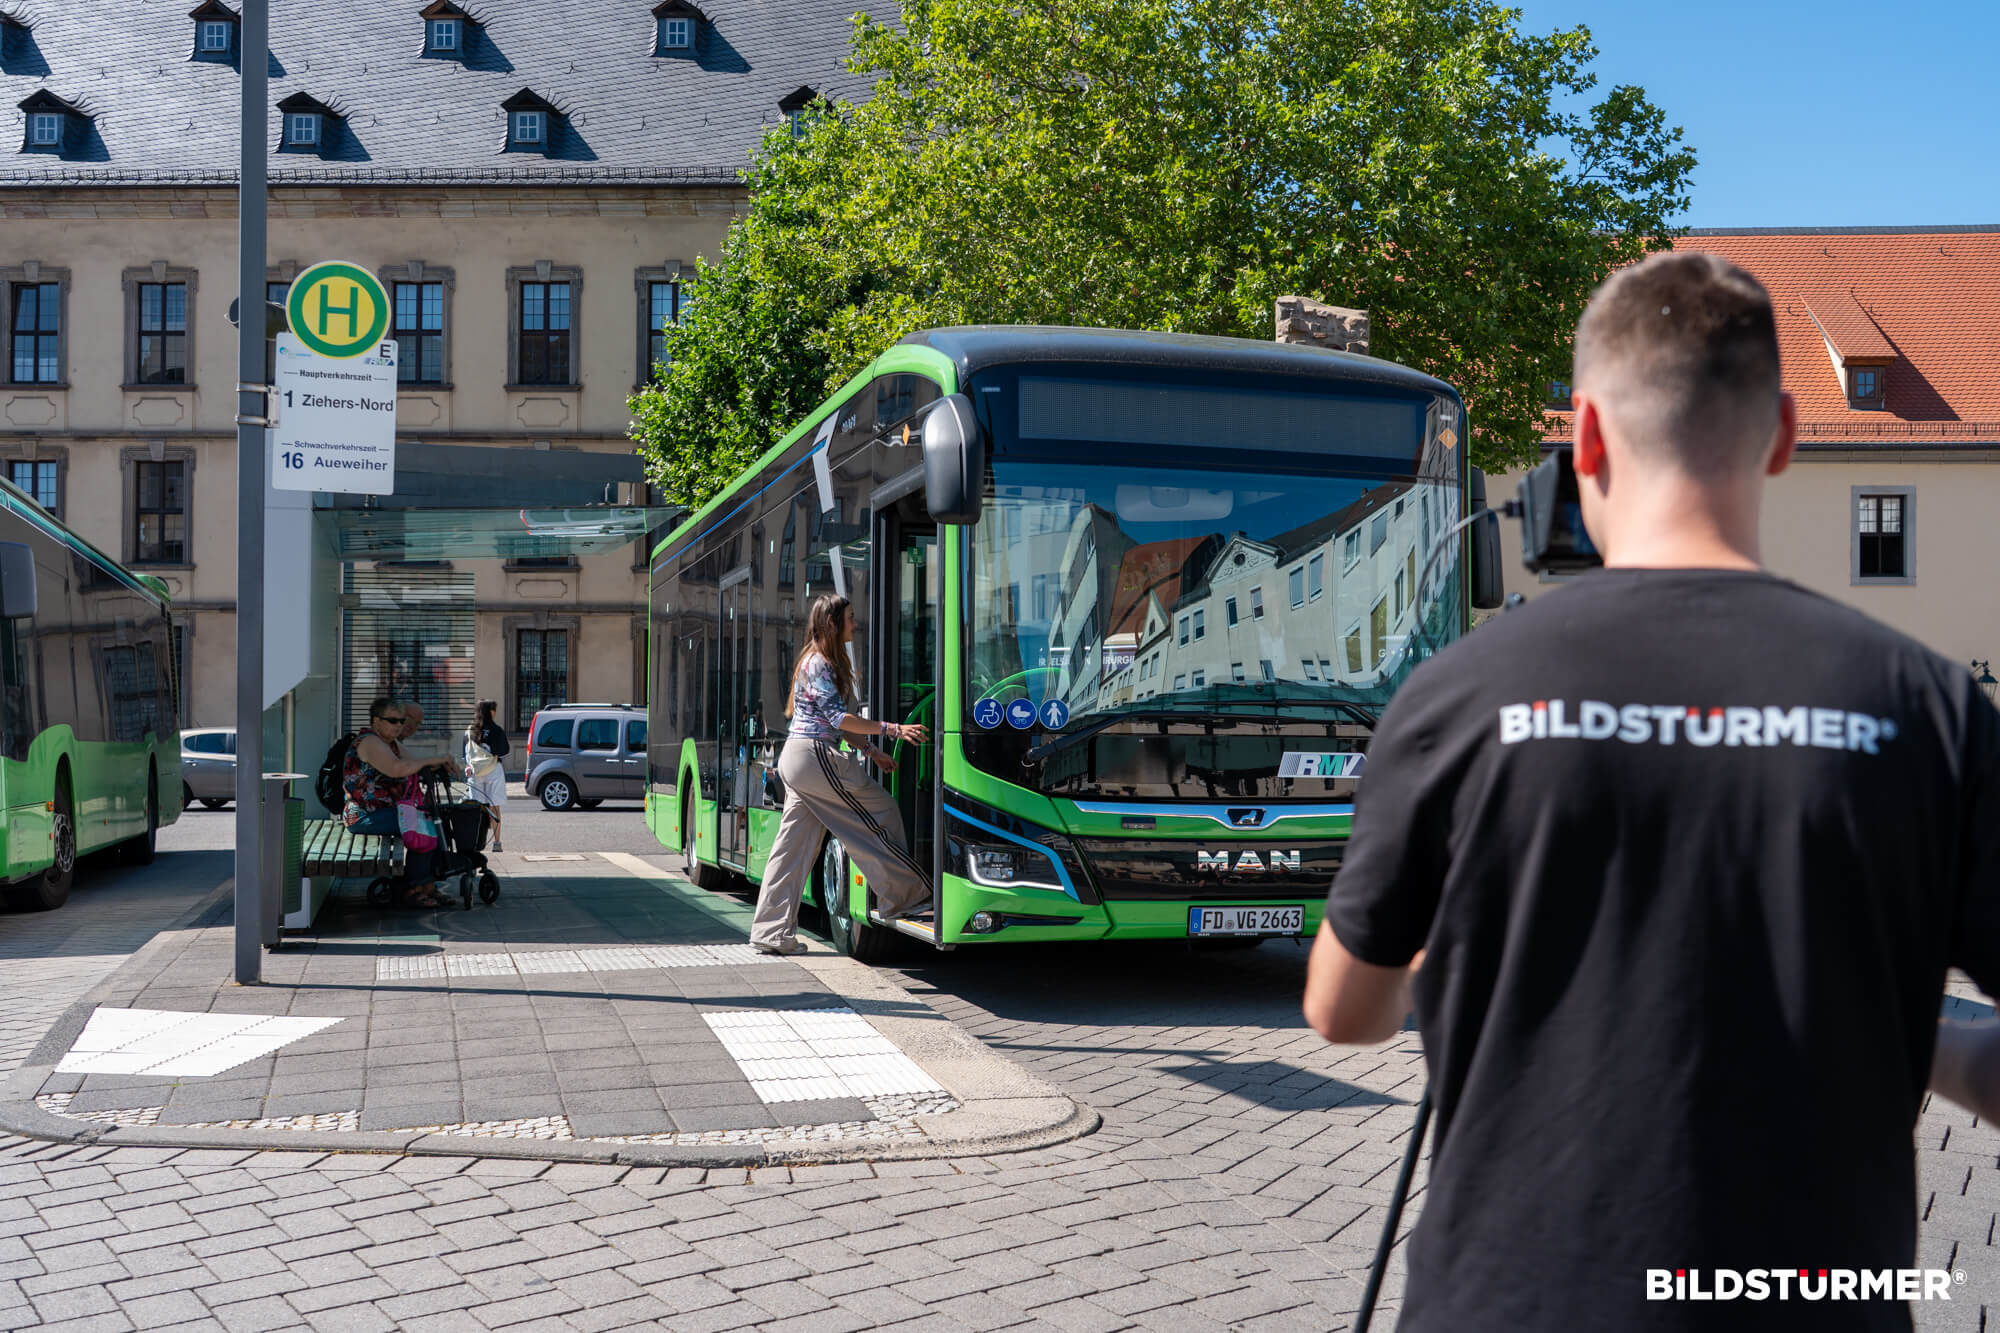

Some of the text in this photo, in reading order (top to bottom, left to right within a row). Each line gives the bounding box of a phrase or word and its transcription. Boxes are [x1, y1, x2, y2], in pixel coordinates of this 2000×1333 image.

[318, 284, 359, 338] H
[380, 343, 392, 359] E
[299, 369, 373, 382] Hauptverkehrszeit
[284, 389, 394, 412] 1 Ziehers-Nord
[294, 440, 377, 453] Schwachverkehrszeit
[281, 451, 388, 471] 16 Aueweiher
[1296, 753, 1362, 777] RMV
[1197, 850, 1301, 872] MAN
[1202, 911, 1224, 930] FD
[1236, 911, 1257, 929] VG
[1260, 910, 1301, 929] 2663
